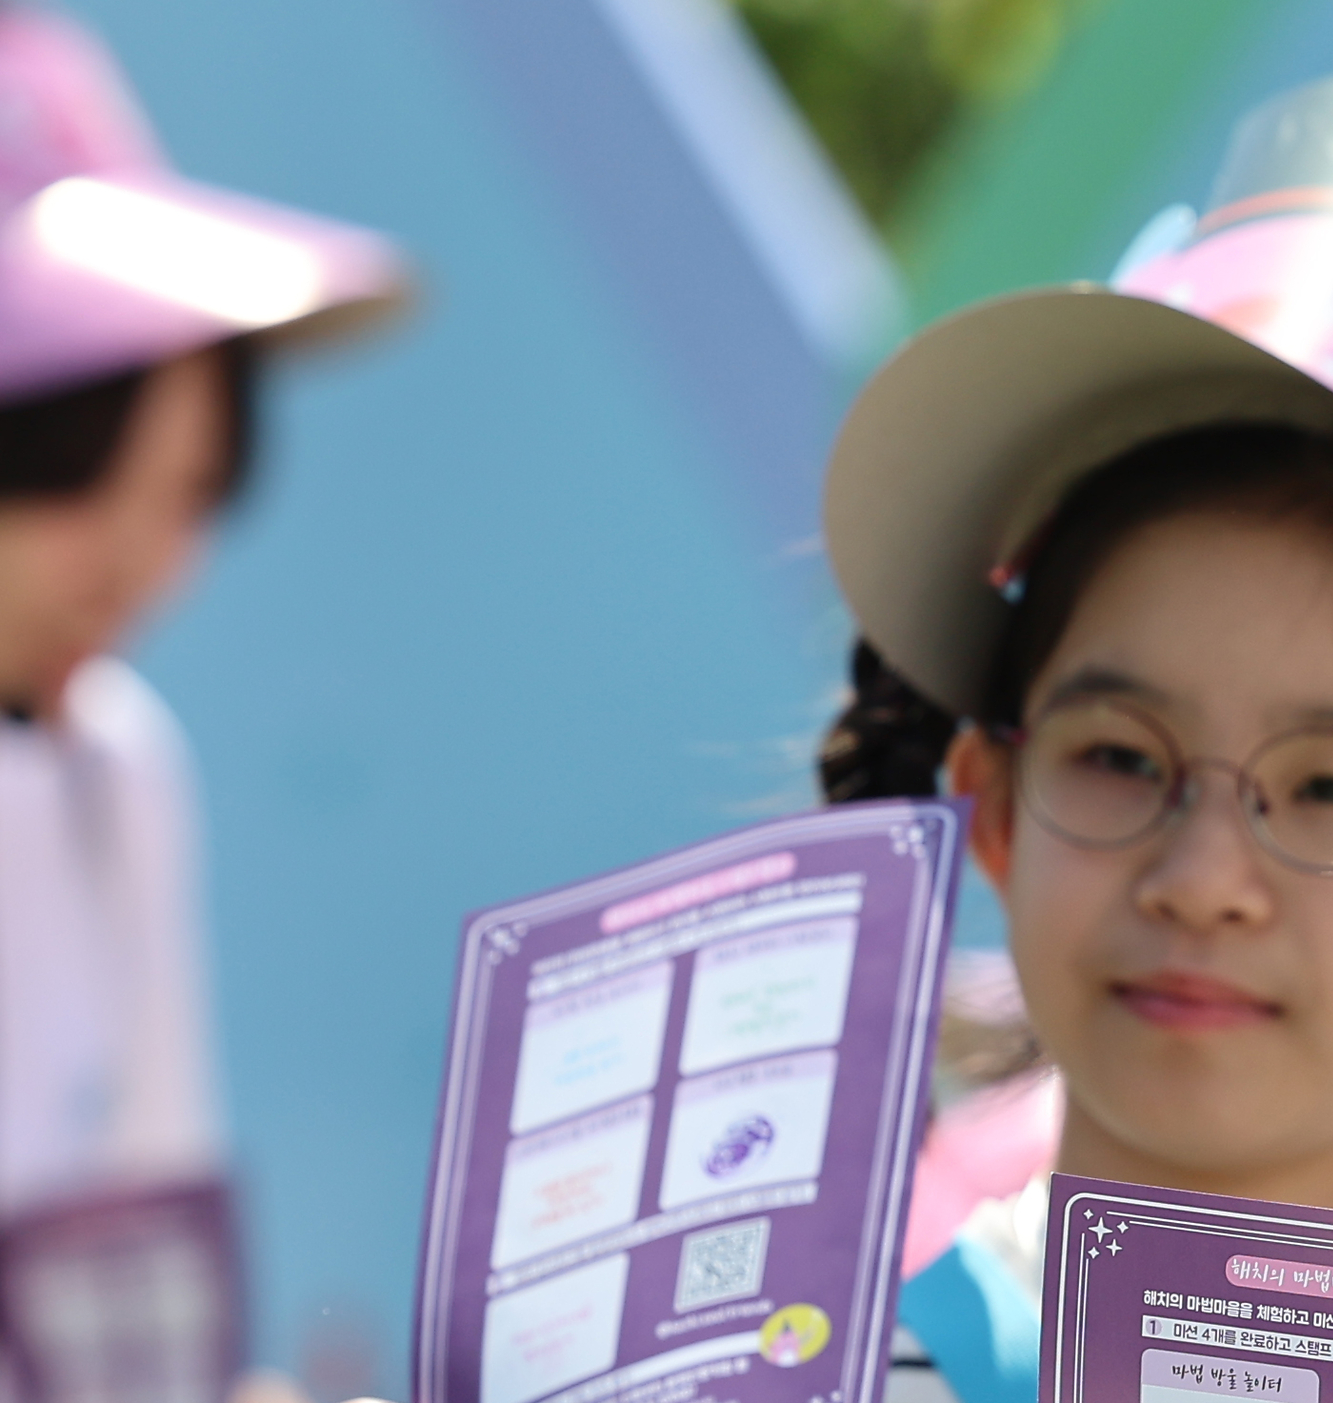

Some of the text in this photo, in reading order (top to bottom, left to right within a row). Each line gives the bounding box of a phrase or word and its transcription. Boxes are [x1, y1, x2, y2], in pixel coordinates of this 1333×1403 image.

[1231, 1258, 1284, 1287] 해치의
[1143, 1289, 1183, 1310] 해치의
[1186, 1296, 1253, 1319] 마법마을을
[1256, 1304, 1310, 1326] 체험하고
[1174, 1323, 1198, 1340] 미션
[1202, 1328, 1236, 1345] 4개를
[1240, 1332, 1292, 1351] 완료하고
[1295, 1339, 1332, 1356] 스탬프
[1172, 1364, 1282, 1393] 마법 방울 놀이터
